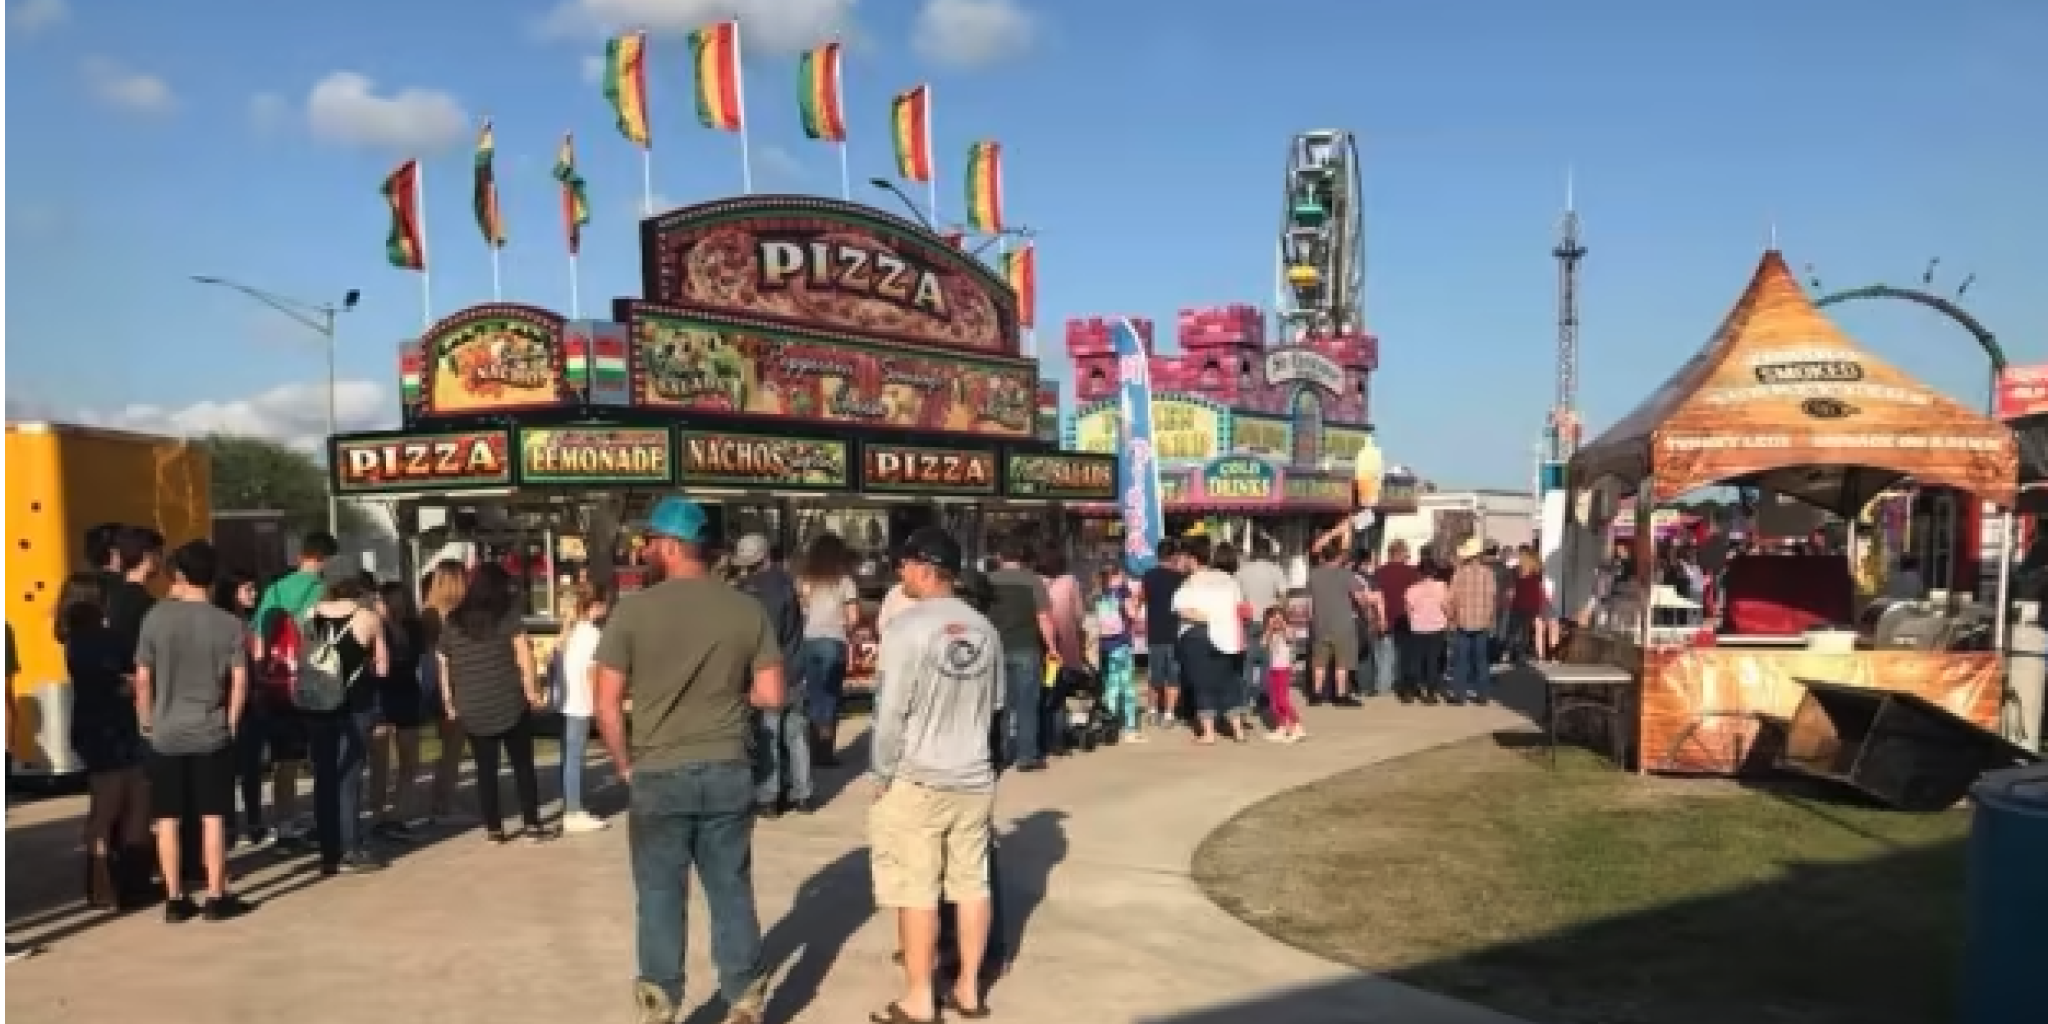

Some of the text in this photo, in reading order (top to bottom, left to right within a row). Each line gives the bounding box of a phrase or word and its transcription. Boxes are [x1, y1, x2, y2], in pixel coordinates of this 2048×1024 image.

[760, 241, 945, 310] PIZZA
[1757, 361, 1862, 383] SMOKED
[349, 441, 500, 478] PIZZA
[531, 446, 664, 472] LEMONADE
[687, 438, 786, 477] NACHOS
[876, 450, 985, 482] PIZZA
[1219, 459, 1261, 477] COLD
[1207, 477, 1271, 497] DRINKS
